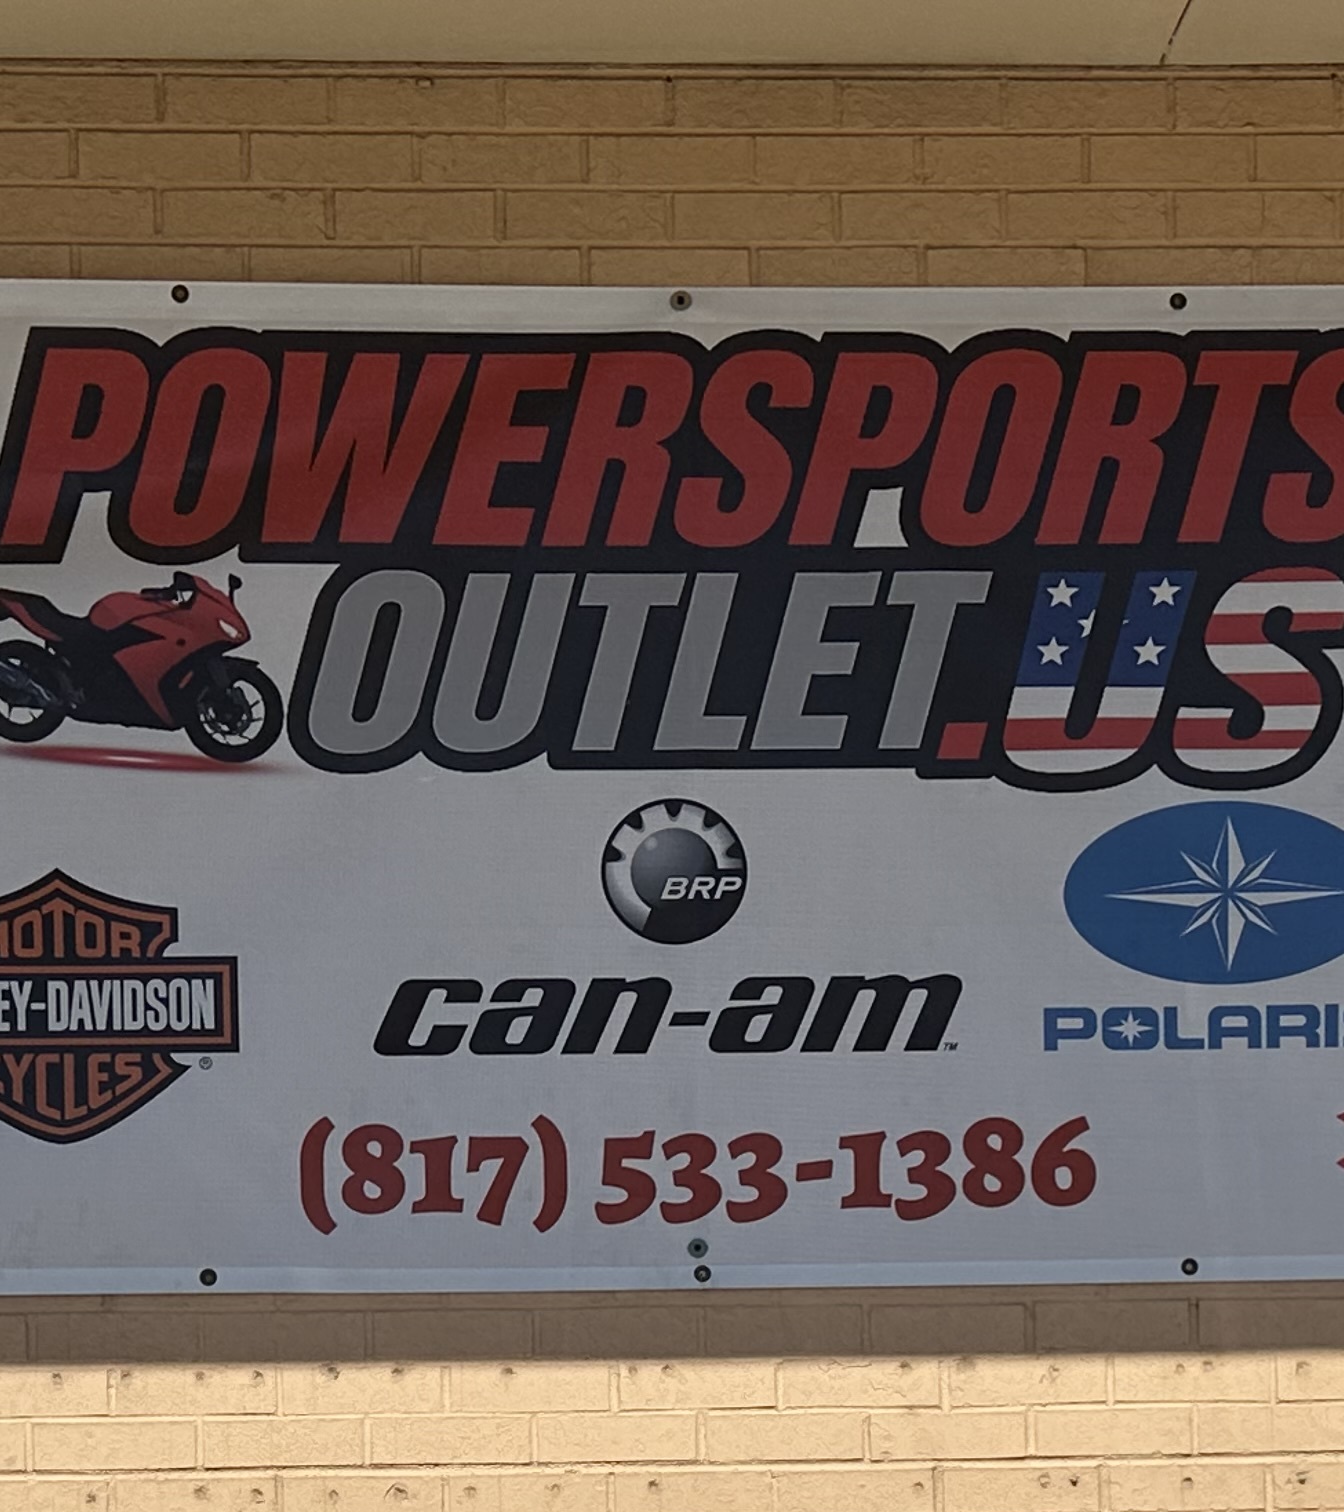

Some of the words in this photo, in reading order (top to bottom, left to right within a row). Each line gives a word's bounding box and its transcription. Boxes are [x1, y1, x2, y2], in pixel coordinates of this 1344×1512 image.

[660, 875, 743, 900] BRP
[299, 1114, 570, 1236] (817)
[593, 1114, 1098, 1225] 533-1386
